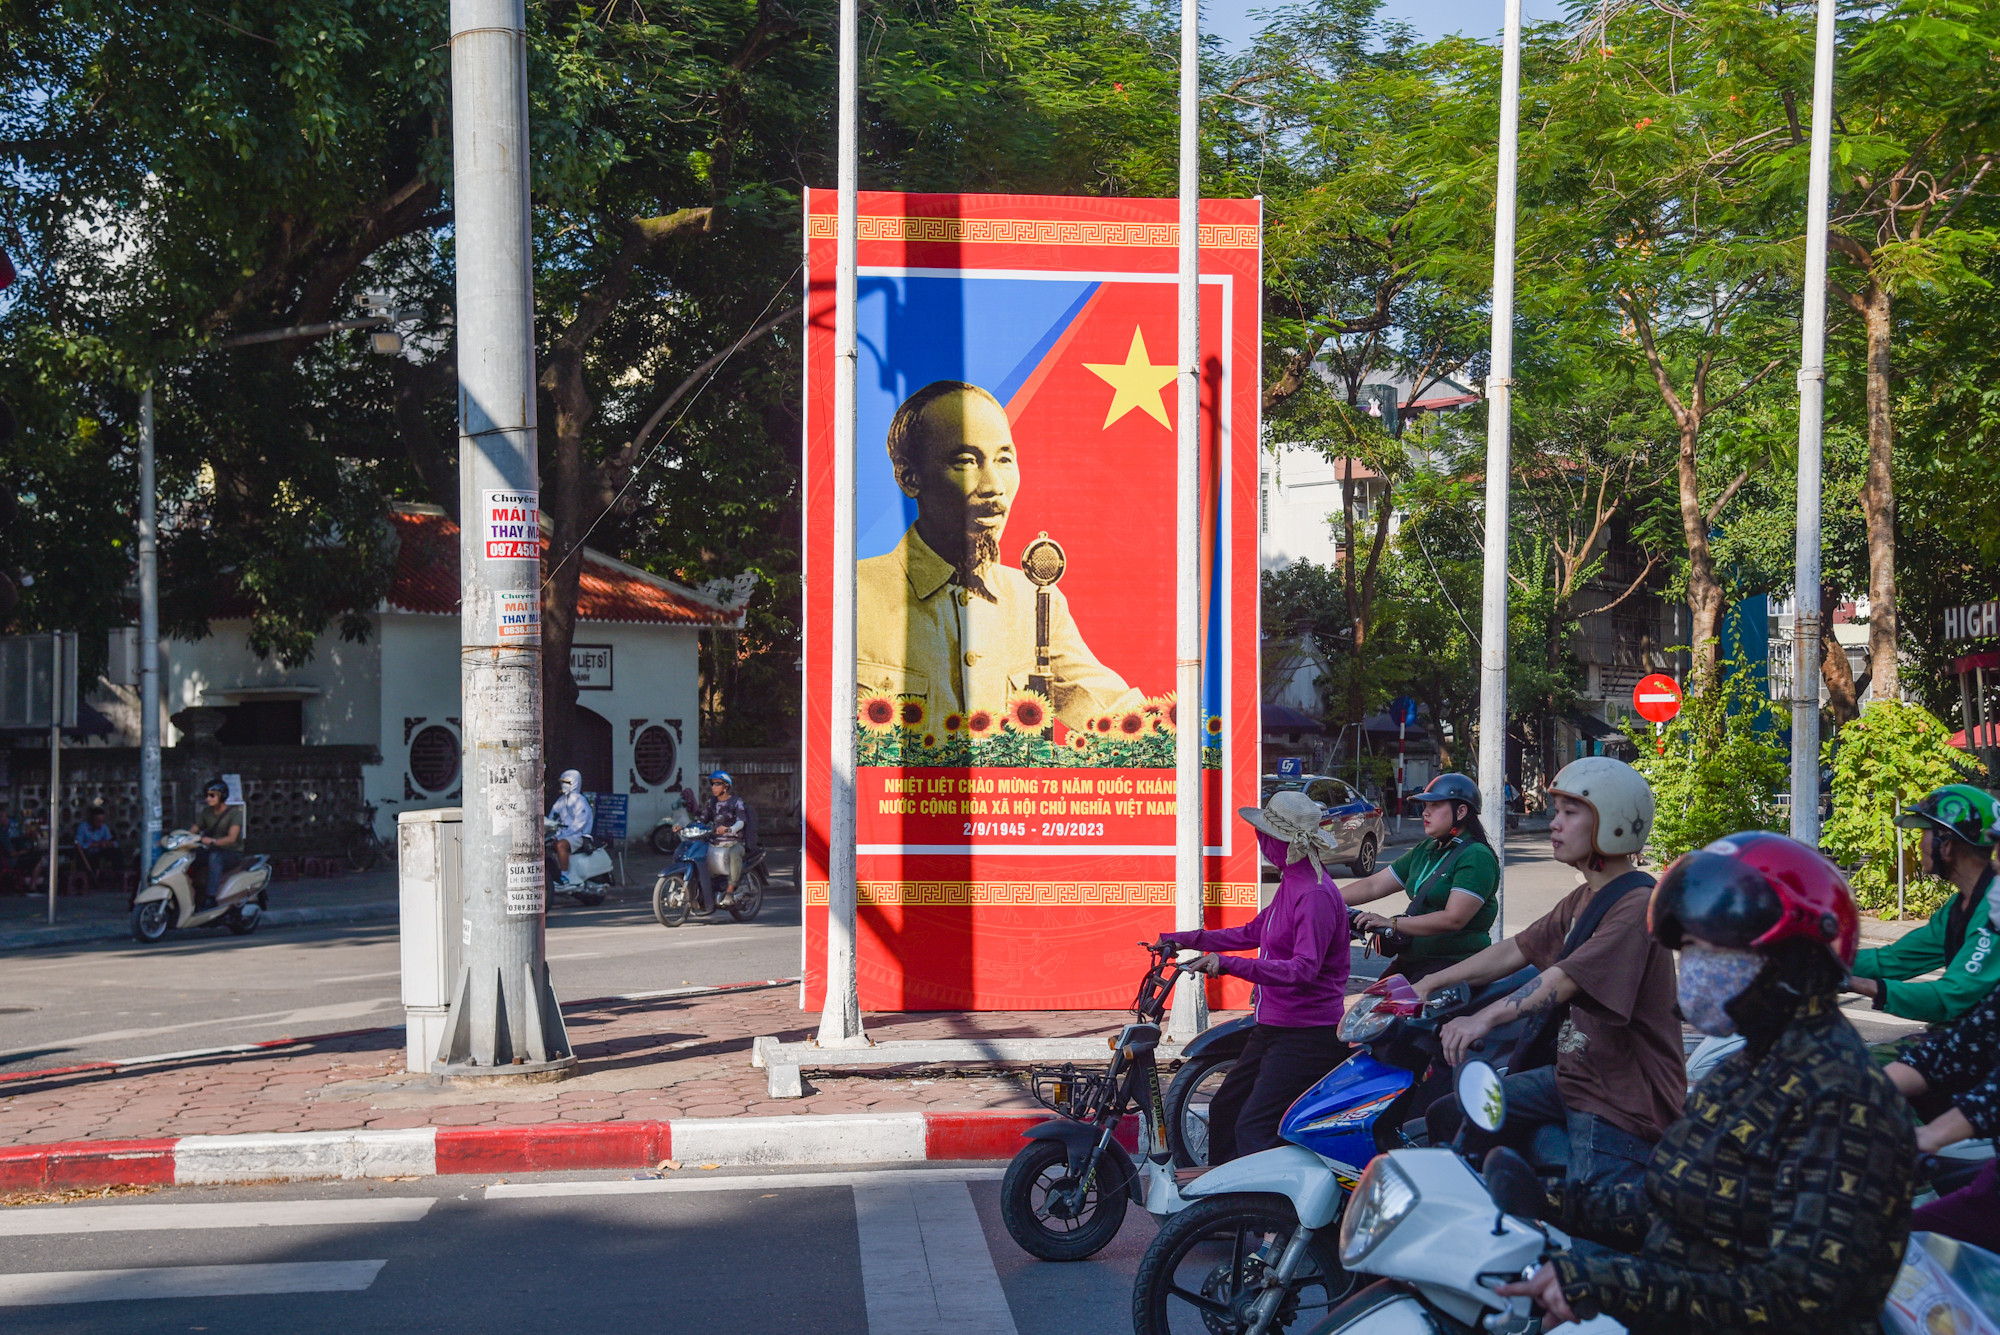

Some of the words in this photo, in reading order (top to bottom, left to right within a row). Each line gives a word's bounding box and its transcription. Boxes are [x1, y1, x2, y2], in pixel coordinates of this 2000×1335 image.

[492, 506, 526, 522] MÁI
[491, 525, 524, 538] THAY
[504, 600, 528, 612] MÁI
[502, 614, 526, 624] THAY
[1282, 760, 1294, 772] G7
[884, 776, 924, 796] NHIỆT
[928, 776, 954, 796] LIỆT
[958, 776, 994, 794] CHÀO
[998, 777, 1038, 794] MỪNG
[1042, 780, 1058, 794] 78
[1062, 777, 1093, 794] NĂM
[1097, 775, 1132, 796] QUỐC
[879, 797, 916, 814] NƯỚC
[920, 797, 956, 818] CỘNG
[960, 797, 988, 814] HÒA
[992, 798, 1010, 814] XÃ
[1014, 798, 1036, 818] HỘI
[1040, 796, 1066, 815] CHỦ
[1070, 798, 1112, 815] NGHĨA
[1115, 798, 1143, 818] VIỆT
[1146, 801, 1176, 816] NAM
[963, 822, 1026, 836] 2/9/1945
[1042, 822, 1104, 836] 2/9/2023
[527, 866, 534, 874] XE
